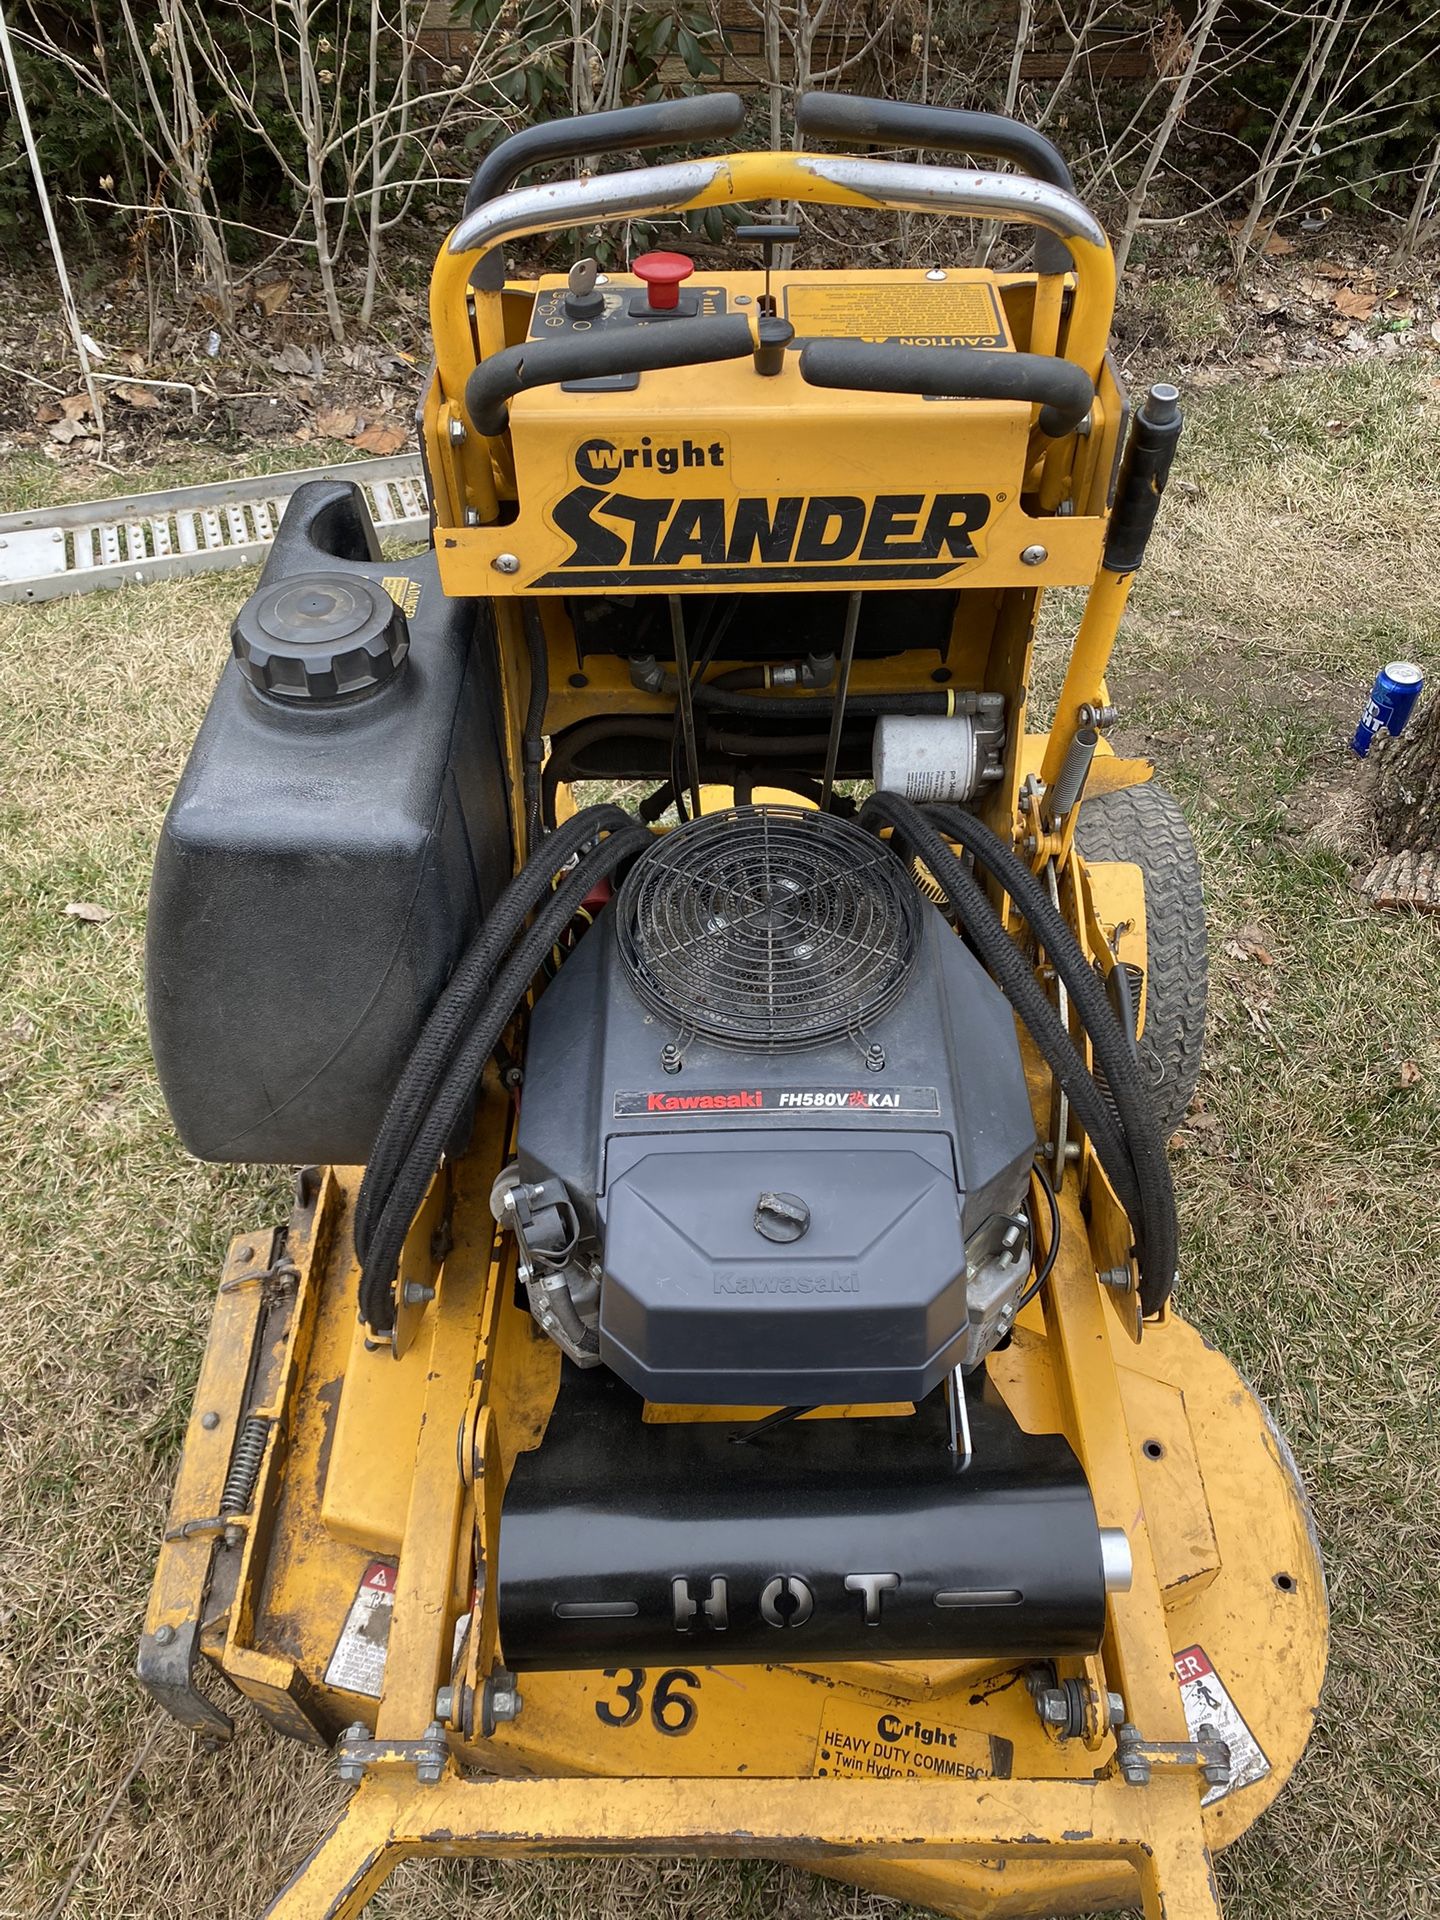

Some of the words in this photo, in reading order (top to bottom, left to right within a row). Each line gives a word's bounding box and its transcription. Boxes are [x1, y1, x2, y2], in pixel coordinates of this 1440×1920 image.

[899, 336, 996, 347] CAUTION
[647, 1091, 763, 1111] Kawasaki
[712, 1270, 860, 1295] Kawasaki
[672, 1572, 903, 1633] HOT
[1174, 1656, 1203, 1681] ER
[595, 1668, 702, 1737] 36
[824, 1731, 870, 1754] HEAVY
[873, 1743, 911, 1764] DUTY
[835, 1752, 863, 1771] Twin
